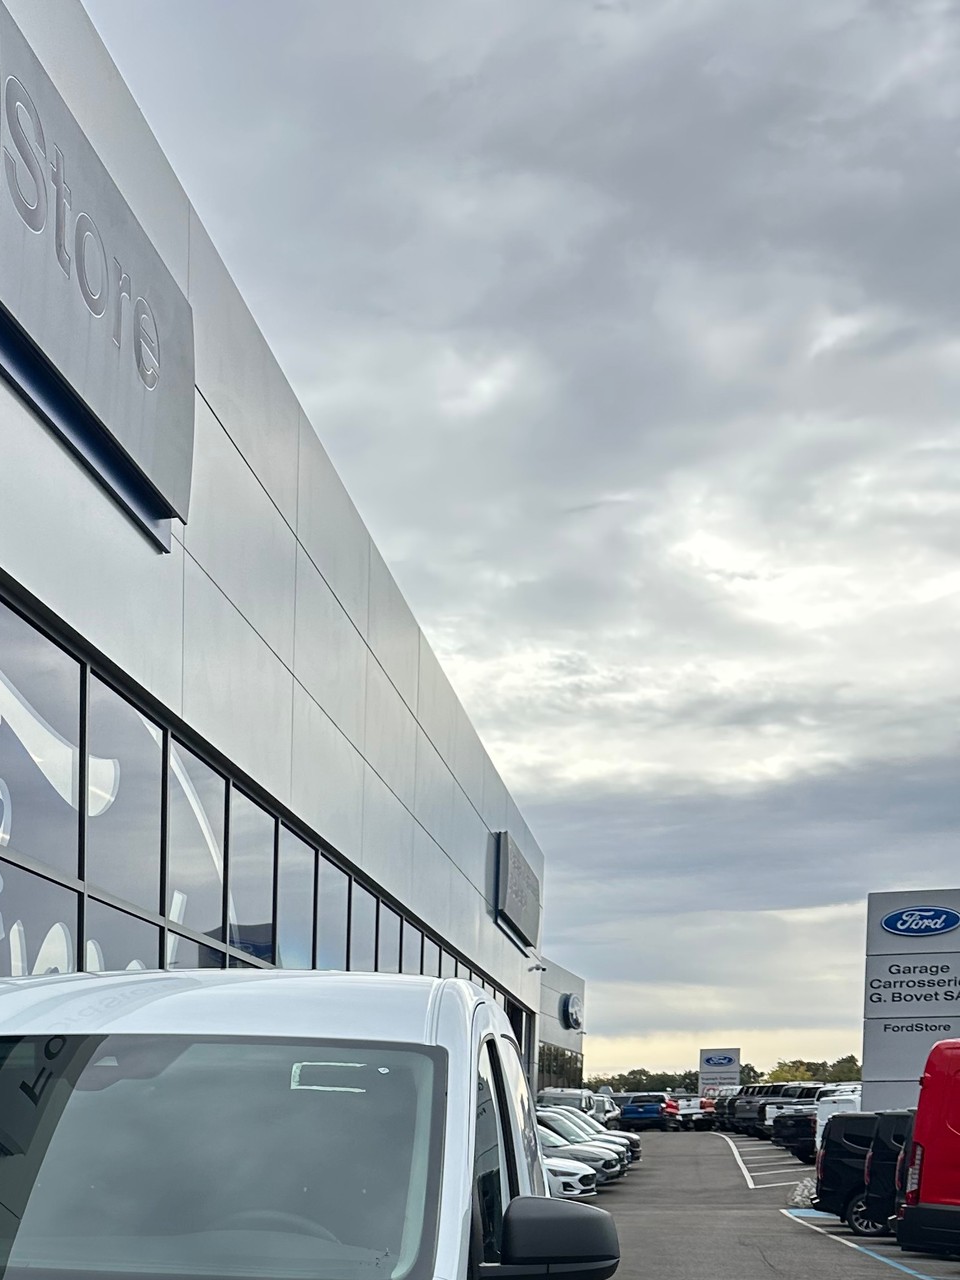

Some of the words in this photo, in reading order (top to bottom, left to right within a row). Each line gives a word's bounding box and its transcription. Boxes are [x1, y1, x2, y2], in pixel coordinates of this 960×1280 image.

[897, 911, 946, 930] Ford
[888, 964, 950, 976] Garage
[869, 976, 960, 989] Carrosseri
[869, 992, 887, 1003] G.
[891, 991, 940, 1003] Bovet
[883, 1023, 951, 1032] FordStore
